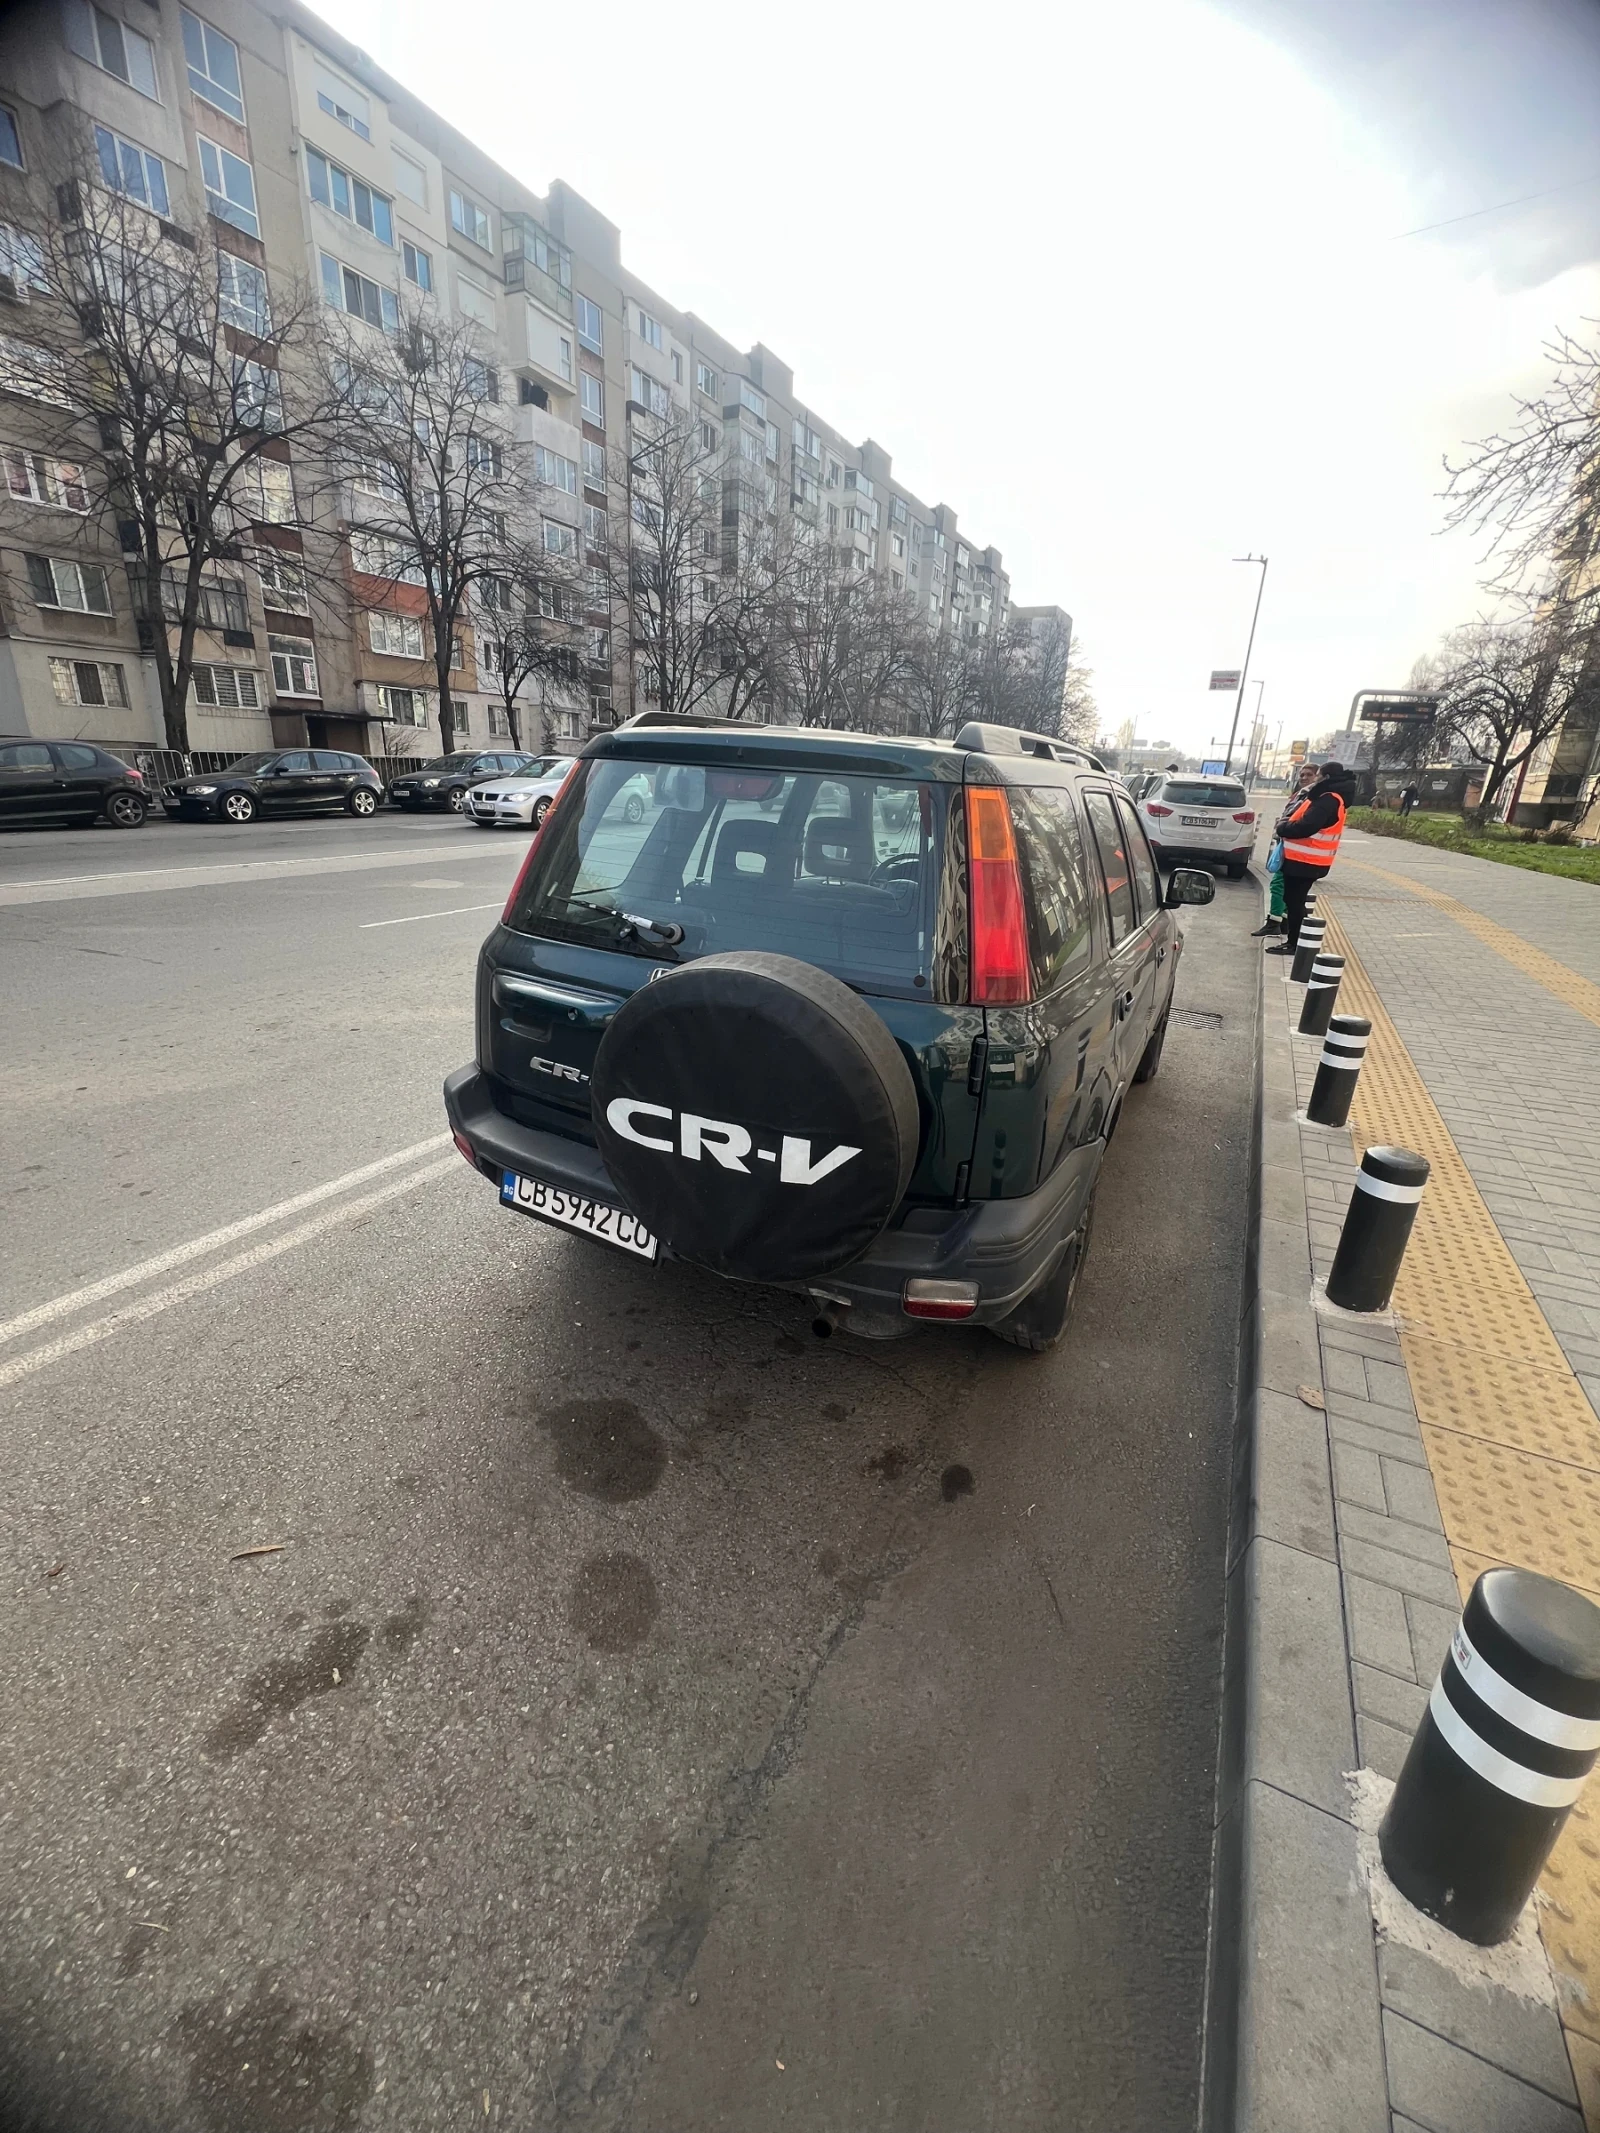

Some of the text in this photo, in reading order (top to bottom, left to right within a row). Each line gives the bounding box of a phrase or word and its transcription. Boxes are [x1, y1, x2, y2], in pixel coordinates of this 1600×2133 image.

[530, 1056, 592, 1086] CR-
[606, 1097, 863, 1185] CR-V
[503, 1185, 514, 1196] BG
